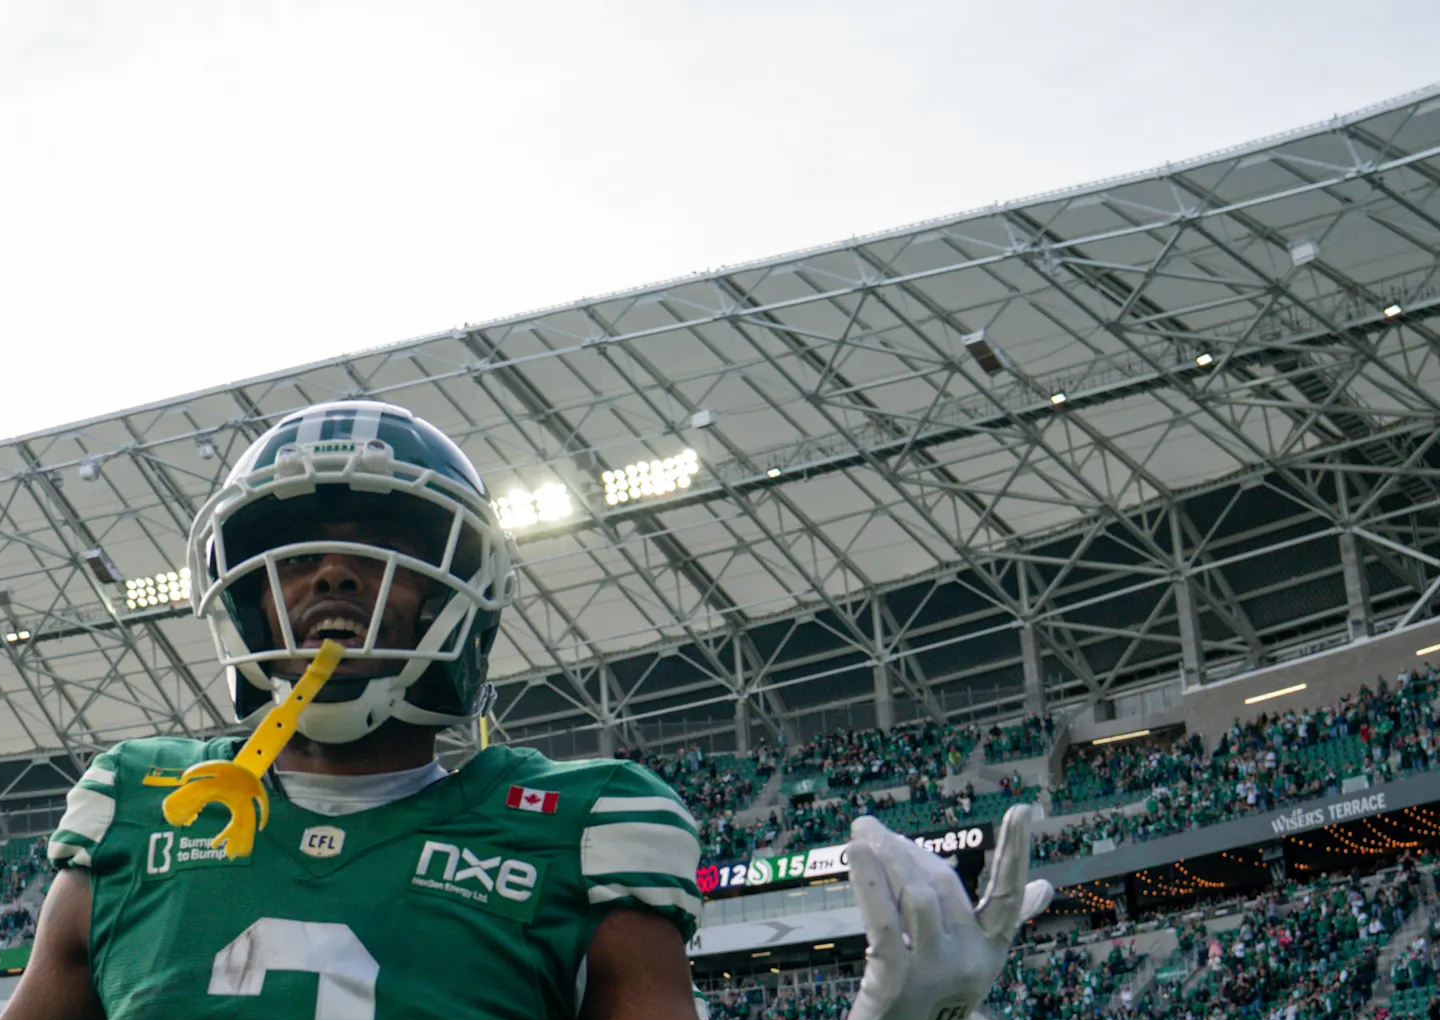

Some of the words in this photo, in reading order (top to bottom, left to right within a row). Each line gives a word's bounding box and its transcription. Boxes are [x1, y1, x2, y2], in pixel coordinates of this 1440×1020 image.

[1328, 793, 1386, 820] TERRACE
[180, 837, 229, 850] Bumpr
[308, 834, 336, 849] CFL
[177, 851, 190, 862] to
[190, 849, 227, 861] Bump
[416, 840, 537, 902] nxe
[719, 864, 746, 887] 12
[777, 856, 805, 878] 15
[809, 858, 833, 871] 4TH
